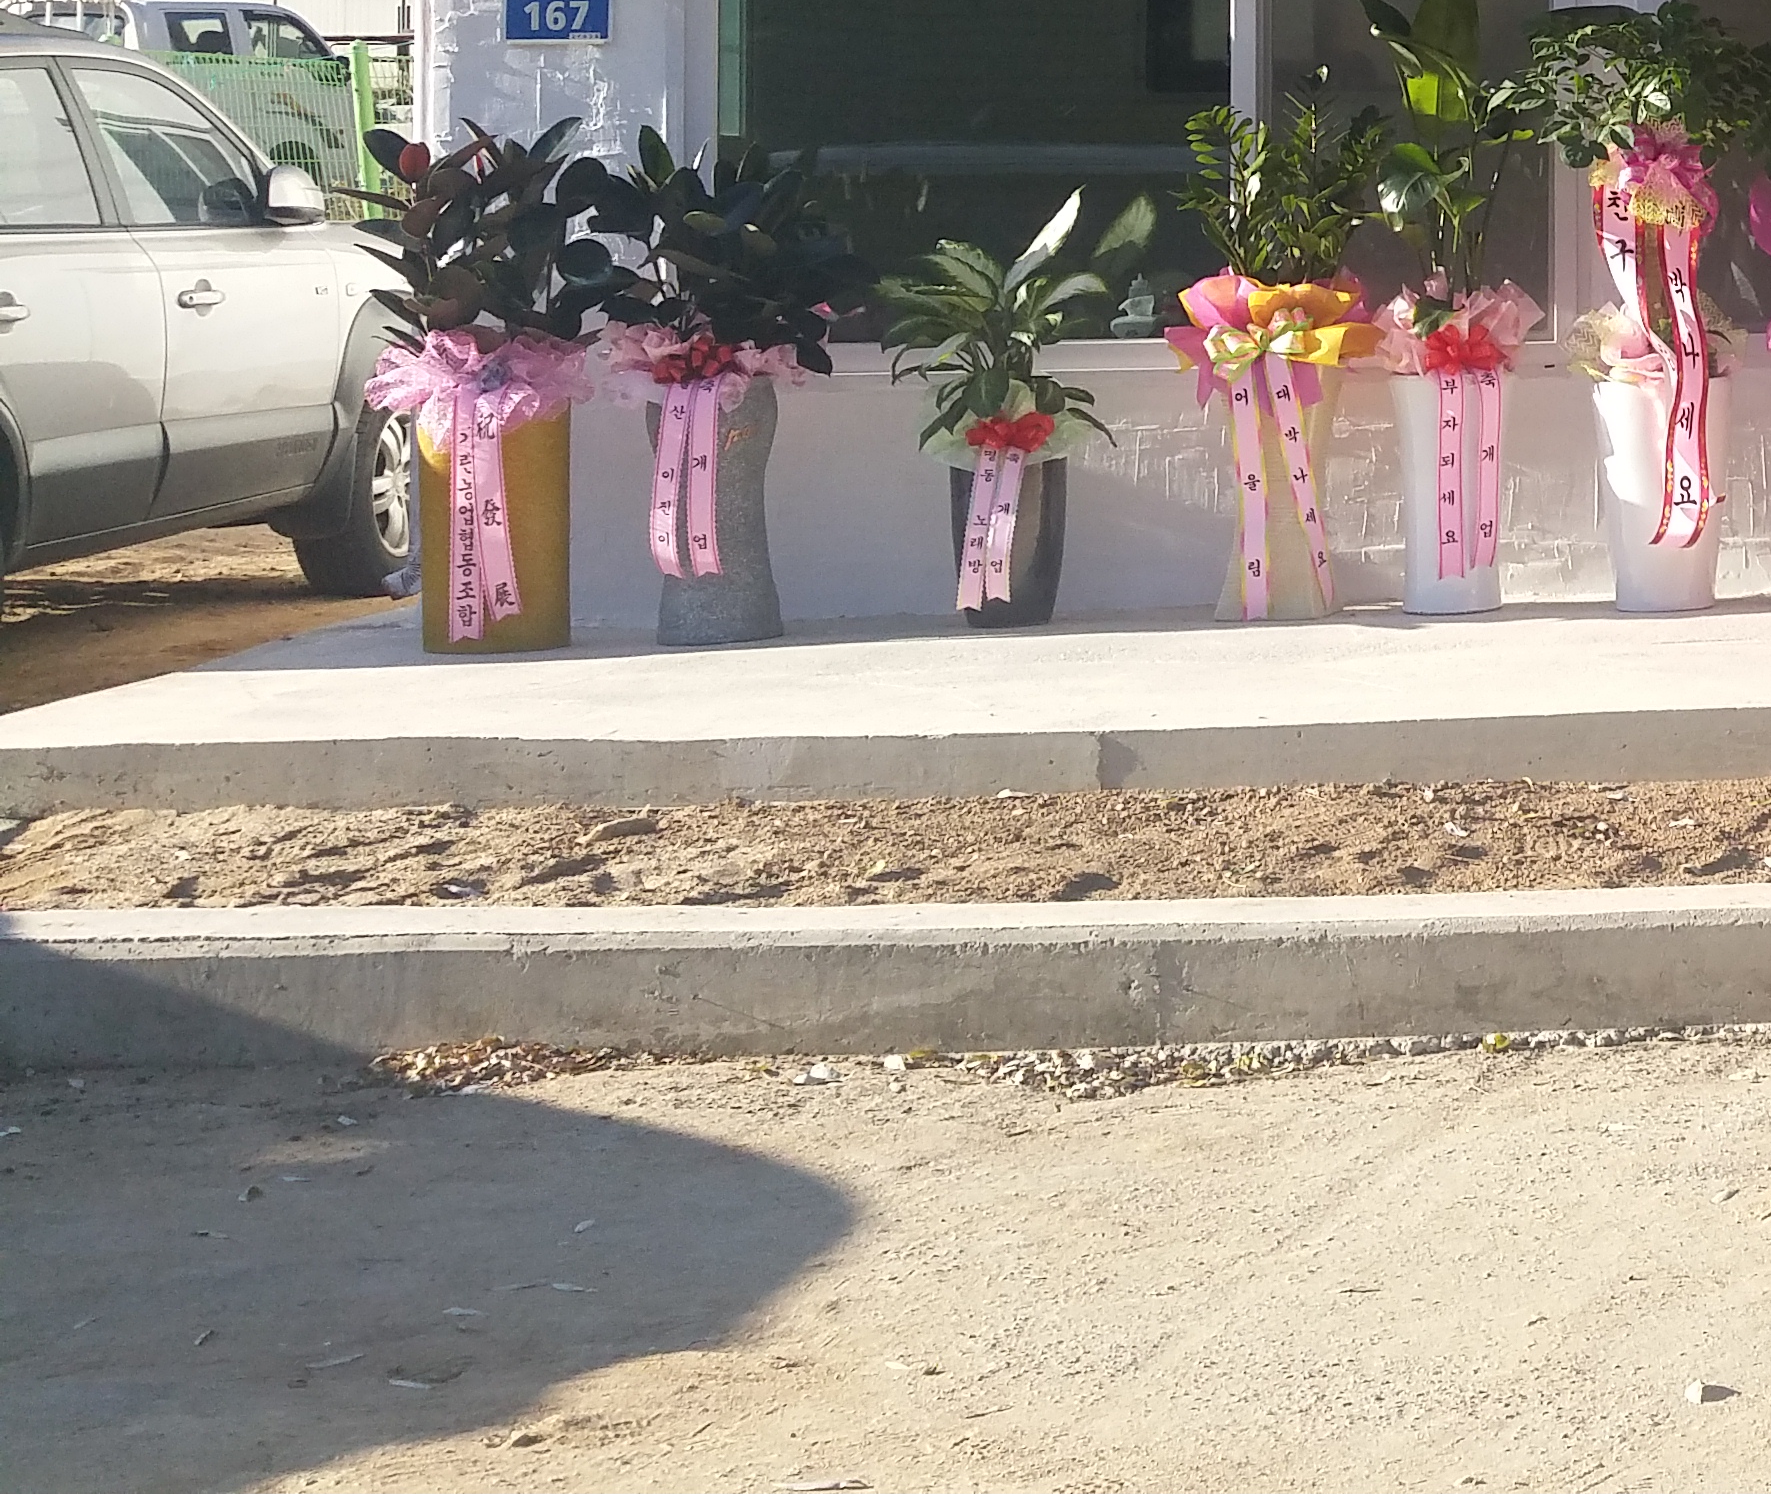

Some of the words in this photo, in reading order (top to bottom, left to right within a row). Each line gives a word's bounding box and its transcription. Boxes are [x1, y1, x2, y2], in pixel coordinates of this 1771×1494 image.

[523, 0, 590, 31] 167
[968, 515, 987, 574] 노래방
[1235, 388, 1261, 577] 어울림
[1276, 385, 1327, 568] 대박나세요
[1440, 379, 1458, 545] 부자되세요
